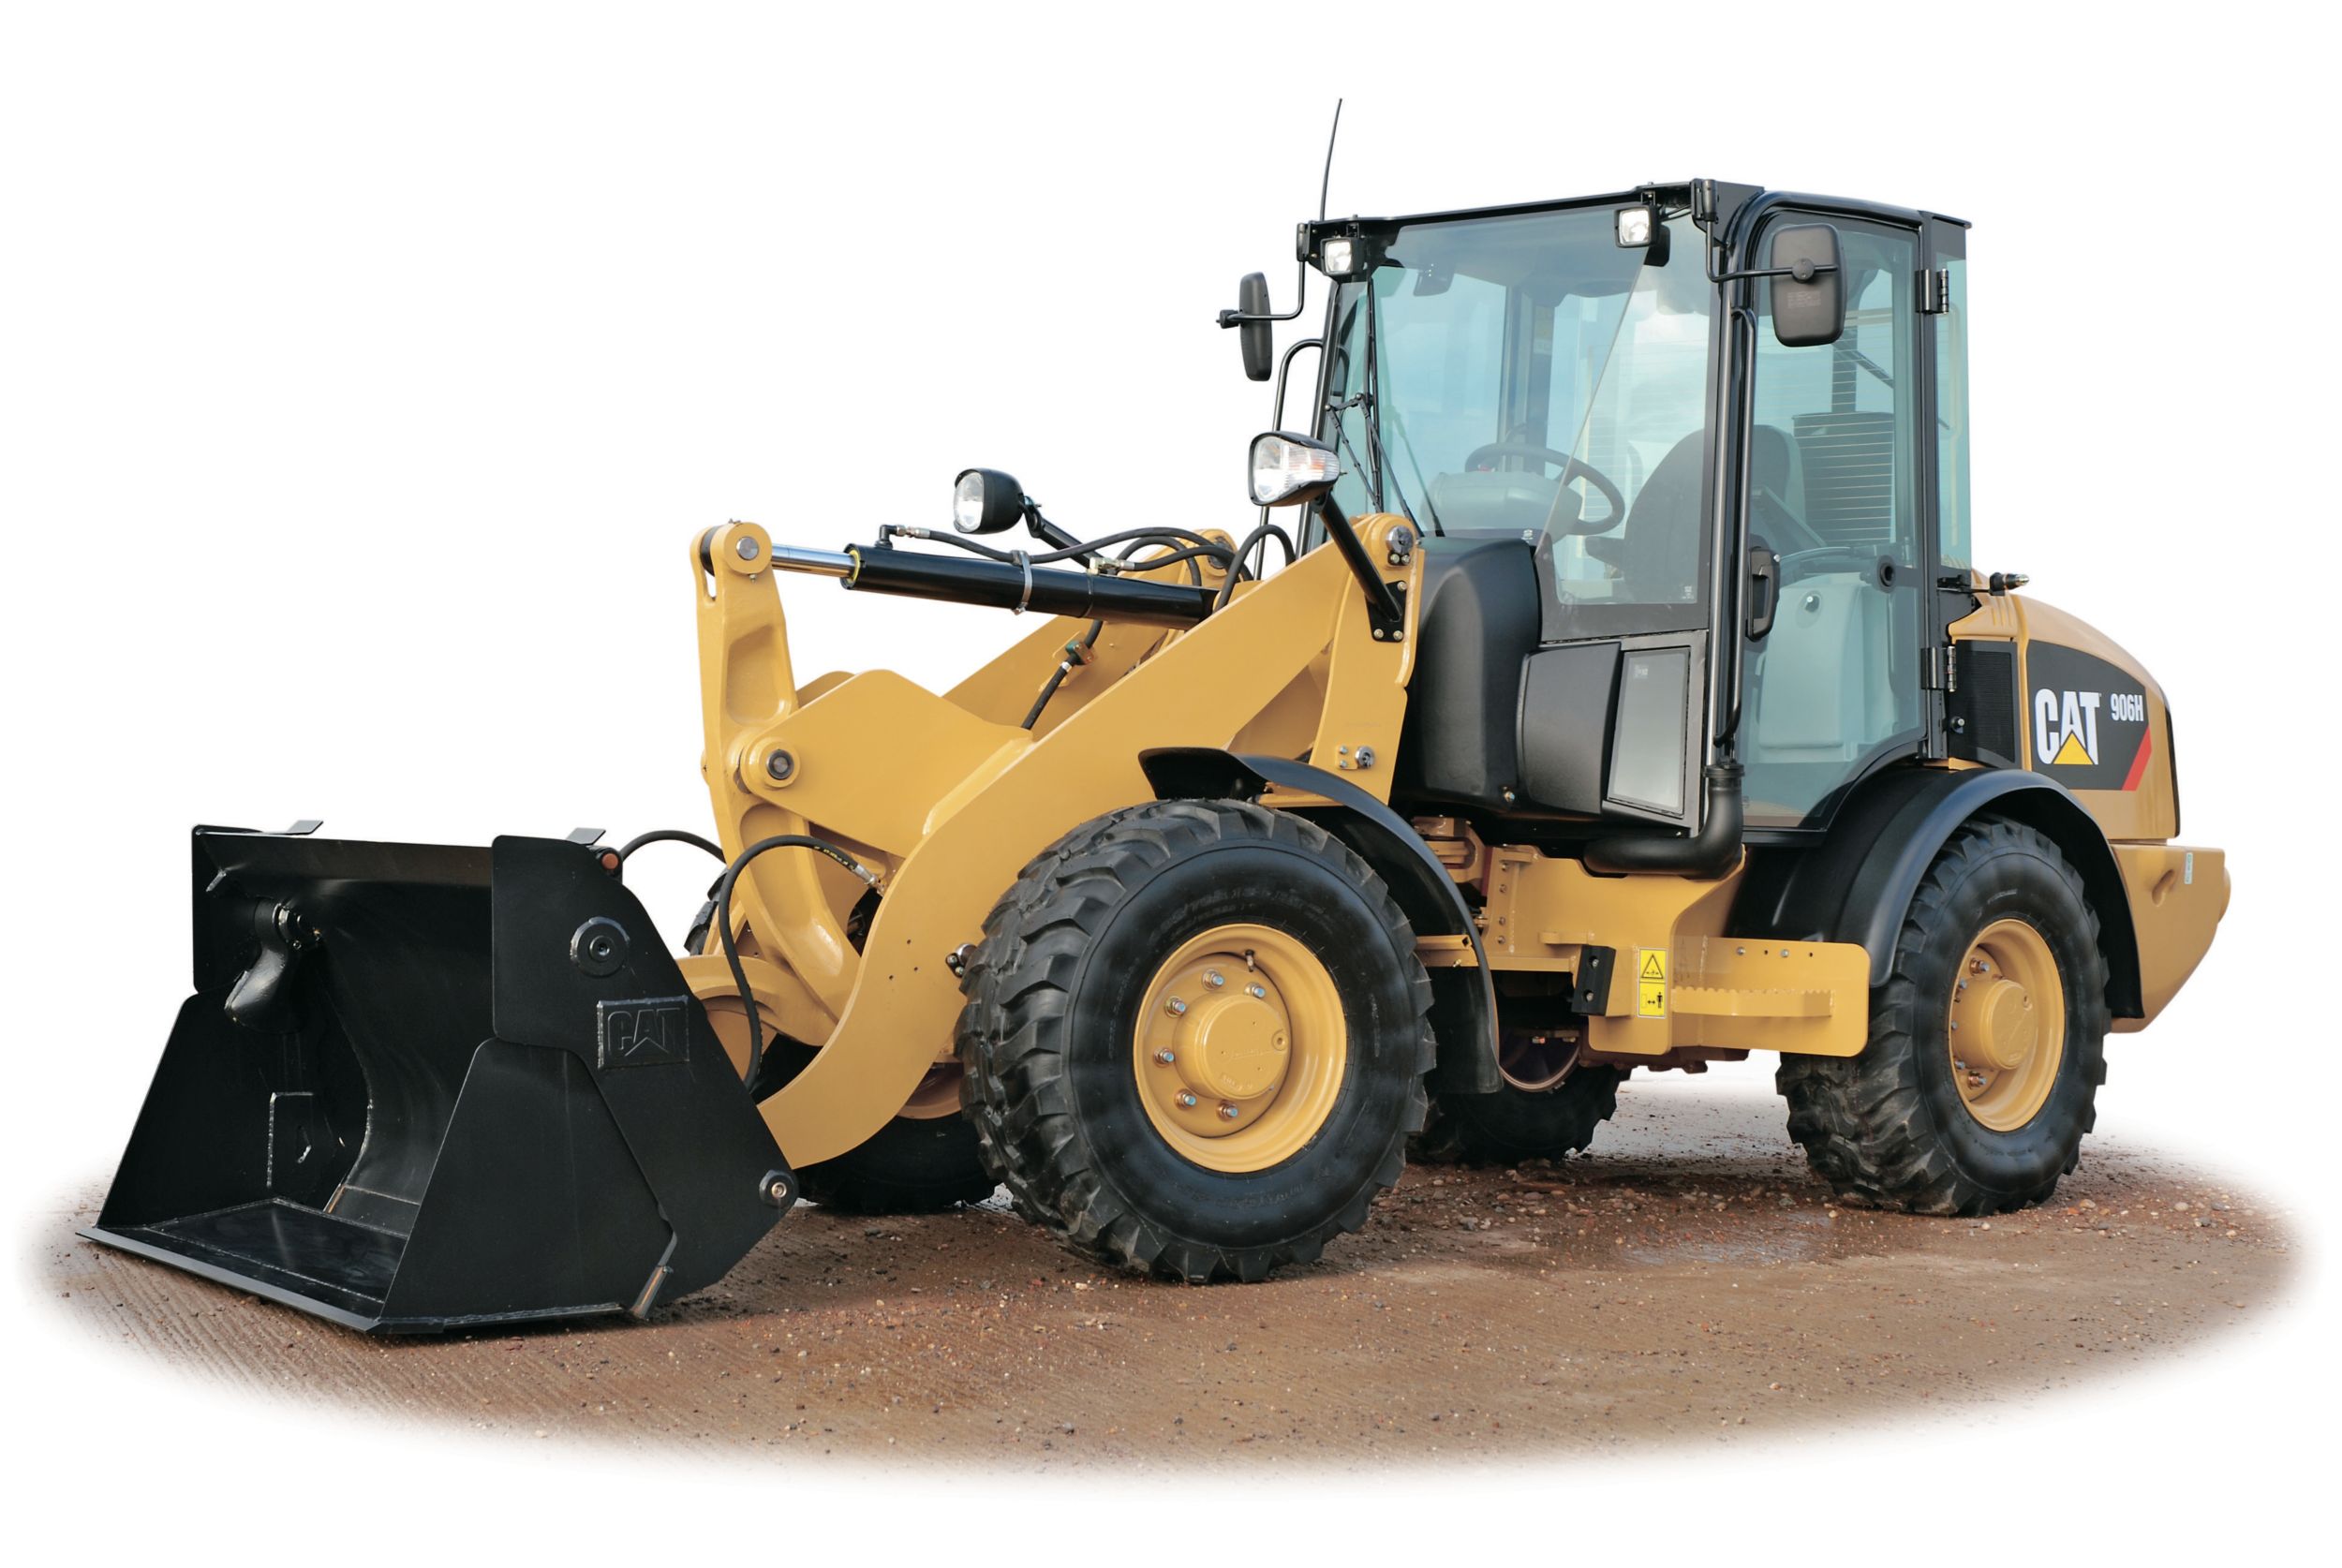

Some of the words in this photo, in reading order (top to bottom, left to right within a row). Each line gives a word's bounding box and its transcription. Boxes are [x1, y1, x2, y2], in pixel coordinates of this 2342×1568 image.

[2035, 688, 2100, 765] CAT
[2110, 693, 2144, 722] 906H
[607, 1007, 681, 1058] CAT
